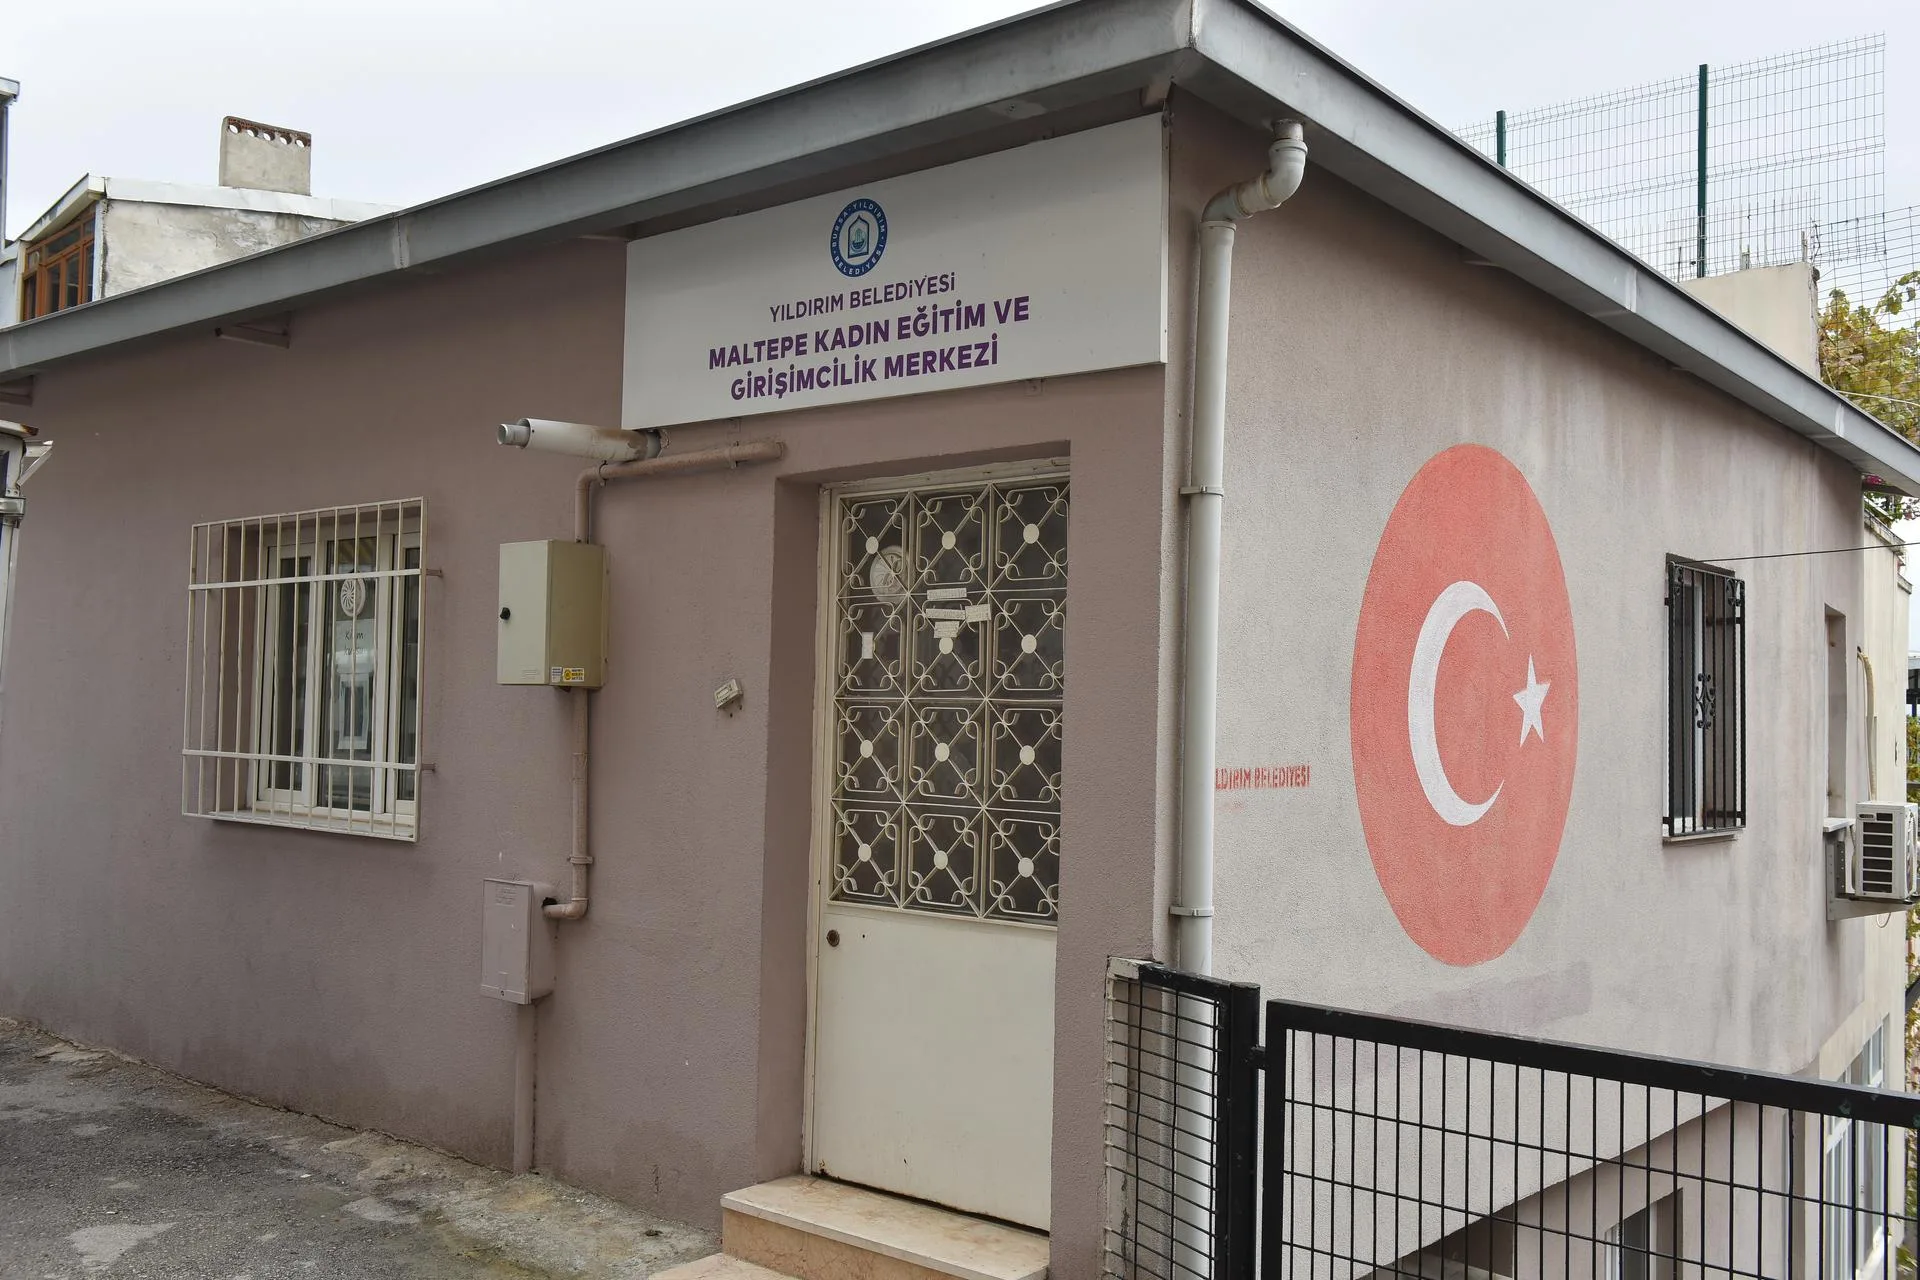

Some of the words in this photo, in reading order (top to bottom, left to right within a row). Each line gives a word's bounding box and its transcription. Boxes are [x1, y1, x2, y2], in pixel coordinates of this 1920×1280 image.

[831, 211, 849, 247] BURSA
[853, 202, 886, 232] YILDIRIM
[709, 333, 808, 370] MALTEPE
[815, 320, 889, 353] KADIN
[897, 300, 986, 340] EĞİTİM
[993, 296, 1030, 324] VE
[770, 293, 844, 322] YILDIRIM
[731, 354, 878, 400] GİRİŞİMCİLİK
[884, 333, 998, 379] MERKEZİ
